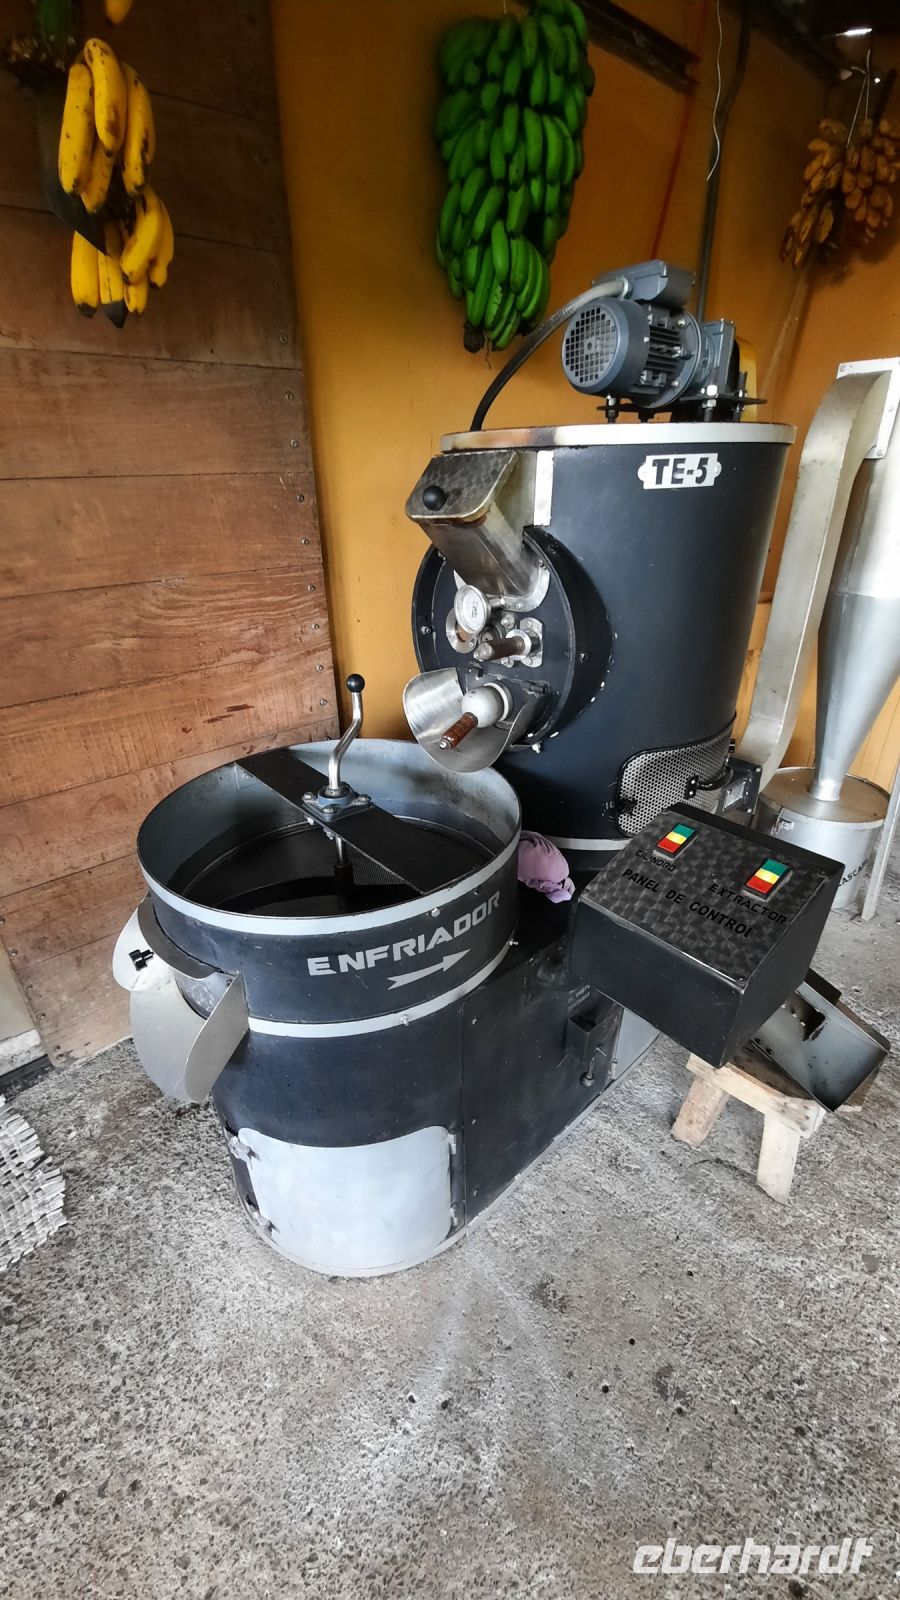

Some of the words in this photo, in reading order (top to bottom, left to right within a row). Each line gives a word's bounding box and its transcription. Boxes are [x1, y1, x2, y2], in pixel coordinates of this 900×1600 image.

[652, 457, 709, 485] TE-5
[622, 868, 660, 893] PANEL
[665, 889, 686, 904] DE
[708, 883, 788, 924] EXTRACTOR
[307, 890, 501, 977] ENFRIADOR
